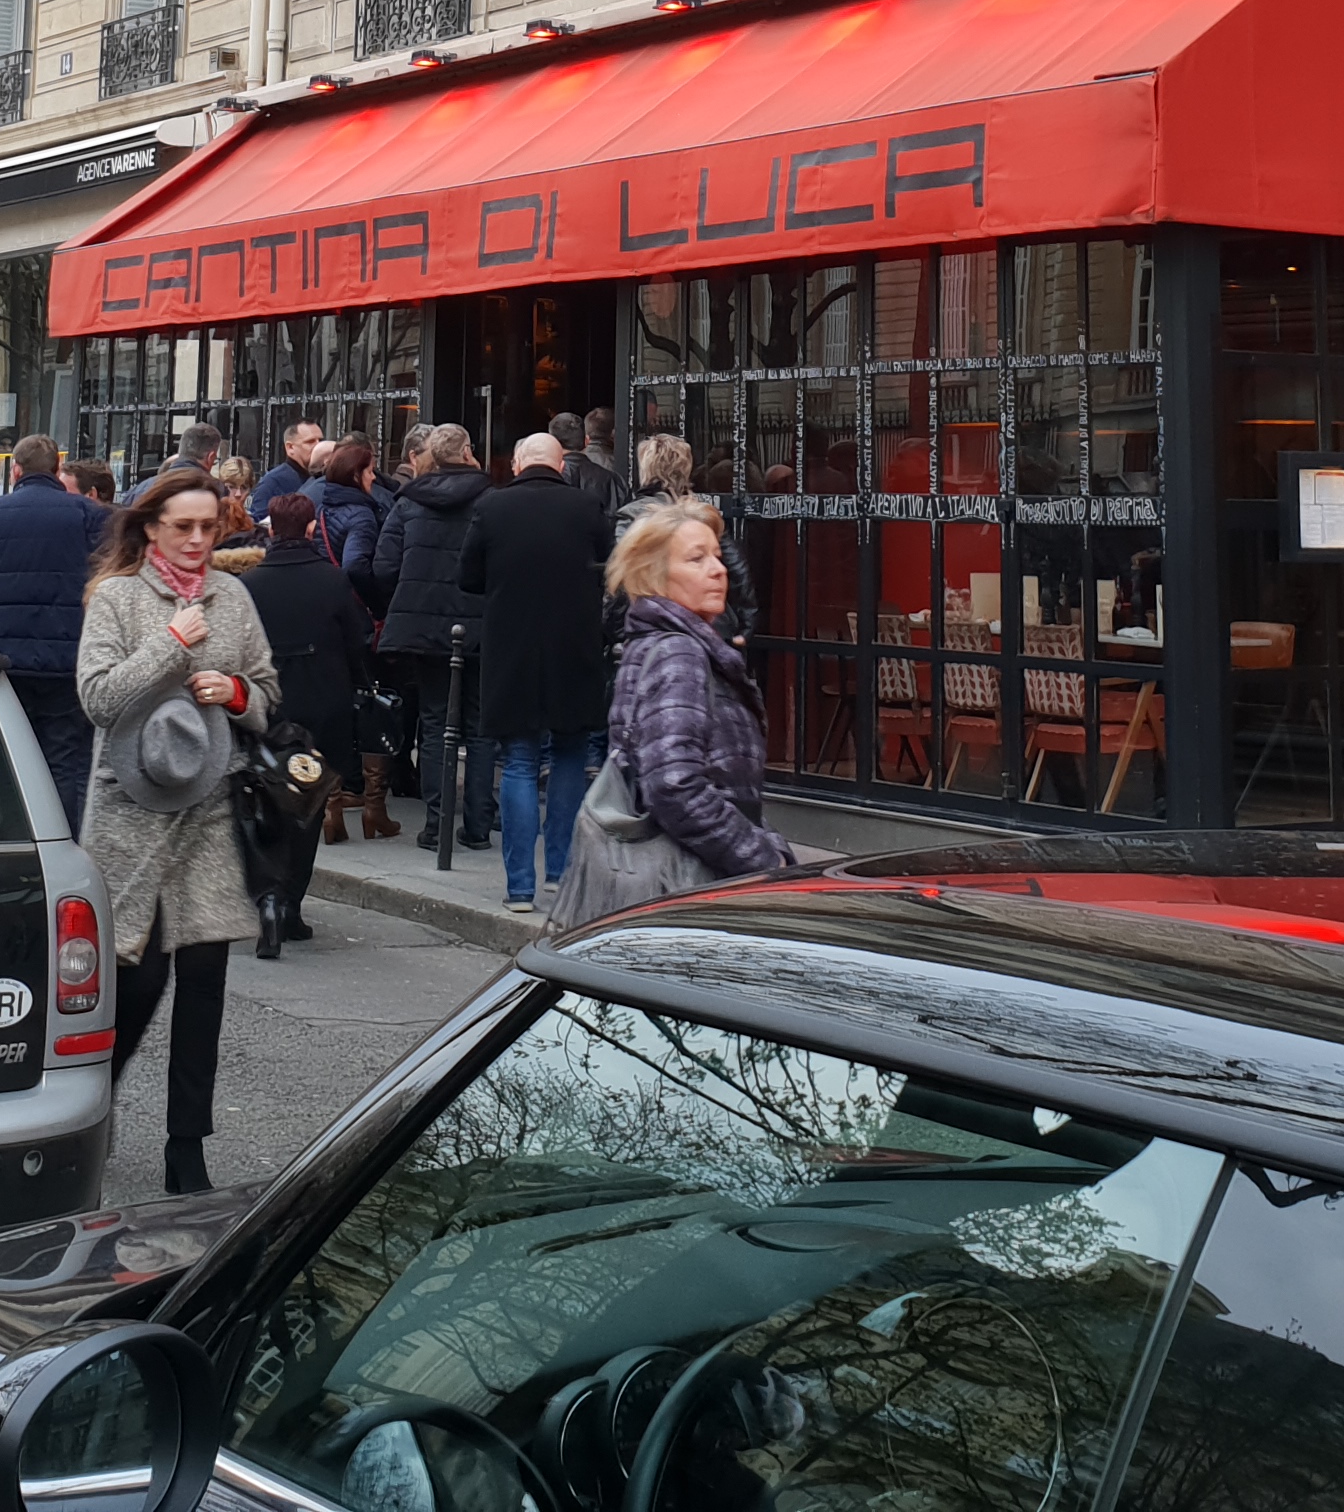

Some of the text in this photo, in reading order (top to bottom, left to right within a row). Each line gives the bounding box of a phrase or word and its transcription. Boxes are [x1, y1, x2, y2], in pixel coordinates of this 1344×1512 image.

[102, 123, 986, 312] CANTINA DI LUCA
[868, 493, 924, 518] APERITIVO
